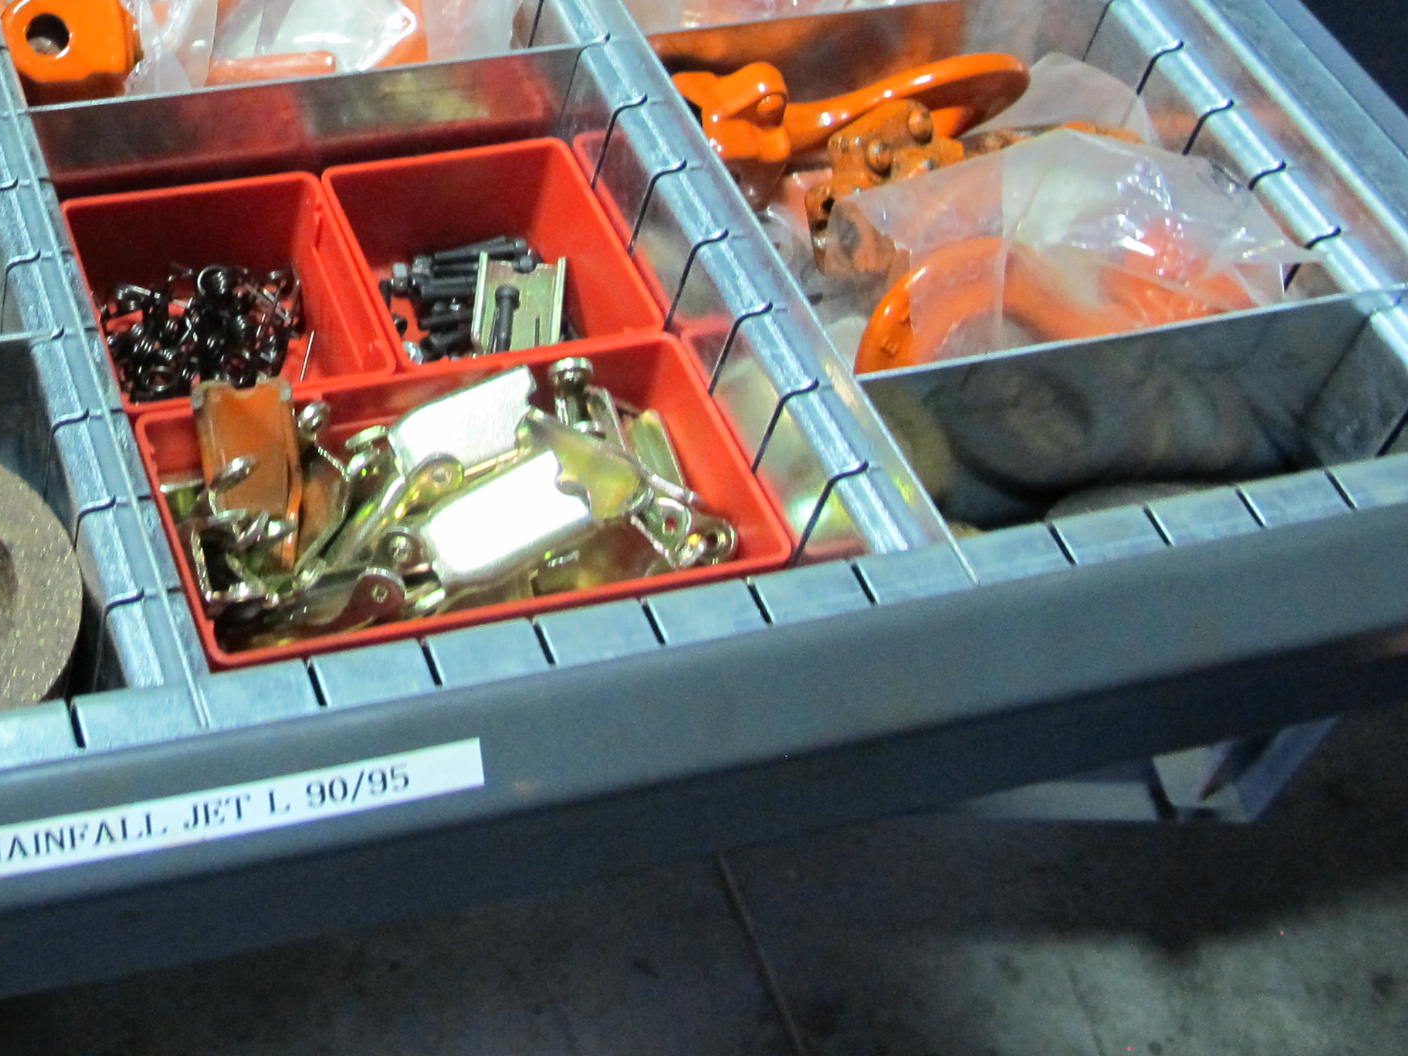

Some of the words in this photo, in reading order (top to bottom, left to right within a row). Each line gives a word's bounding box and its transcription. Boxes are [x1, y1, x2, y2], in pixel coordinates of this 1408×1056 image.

[182, 792, 252, 830] JET
[267, 789, 292, 815] L
[304, 763, 412, 809] 90/95
